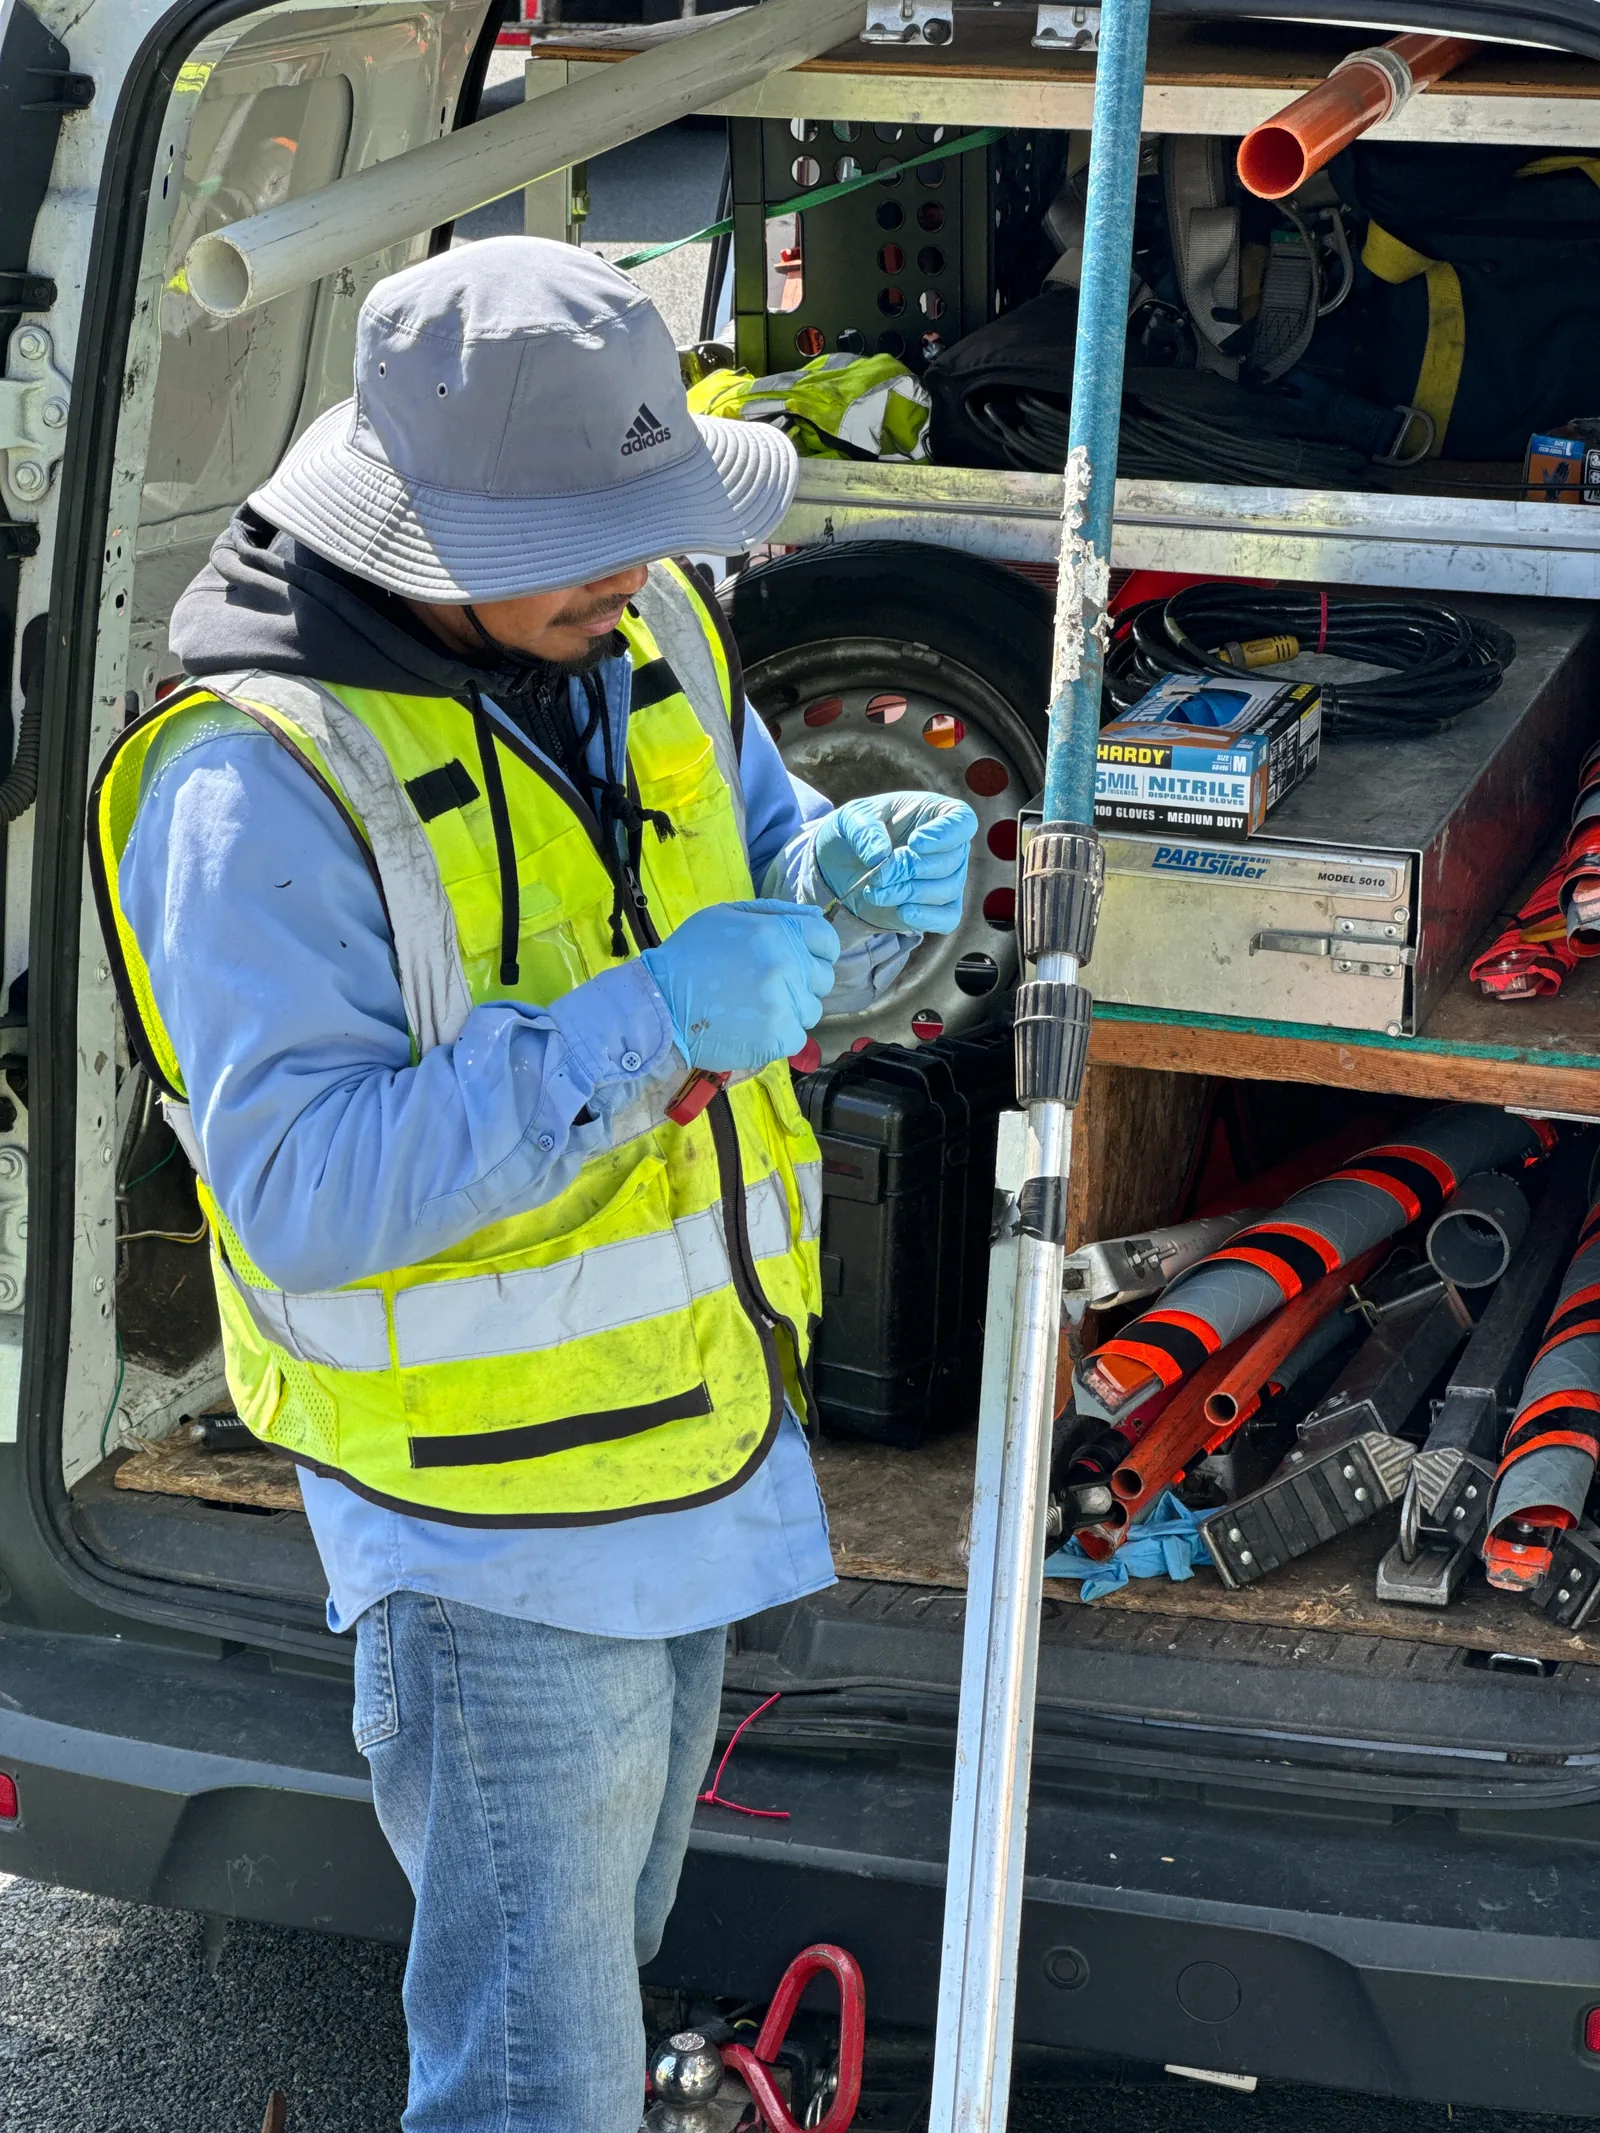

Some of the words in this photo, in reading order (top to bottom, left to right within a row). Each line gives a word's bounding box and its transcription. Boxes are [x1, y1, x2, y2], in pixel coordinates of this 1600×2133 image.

[621, 427, 671, 456] adidas
[1097, 744, 1165, 766] HARDY
[1216, 754, 1230, 762] SIZE
[1233, 755, 1246, 773] M
[1107, 788, 1138, 797] THICKNESS
[1148, 776, 1244, 799] NITRILE
[1148, 792, 1205, 803] DISPOSABLE
[1209, 795, 1245, 806] GLOVES
[1094, 805, 1112, 818] 100
[1116, 806, 1155, 821] GLOVES
[1167, 811, 1213, 826] MEDIUM
[1216, 816, 1244, 829] DUTY
[1317, 872, 1356, 885] MODEL
[1359, 876, 1385, 888] 5010
